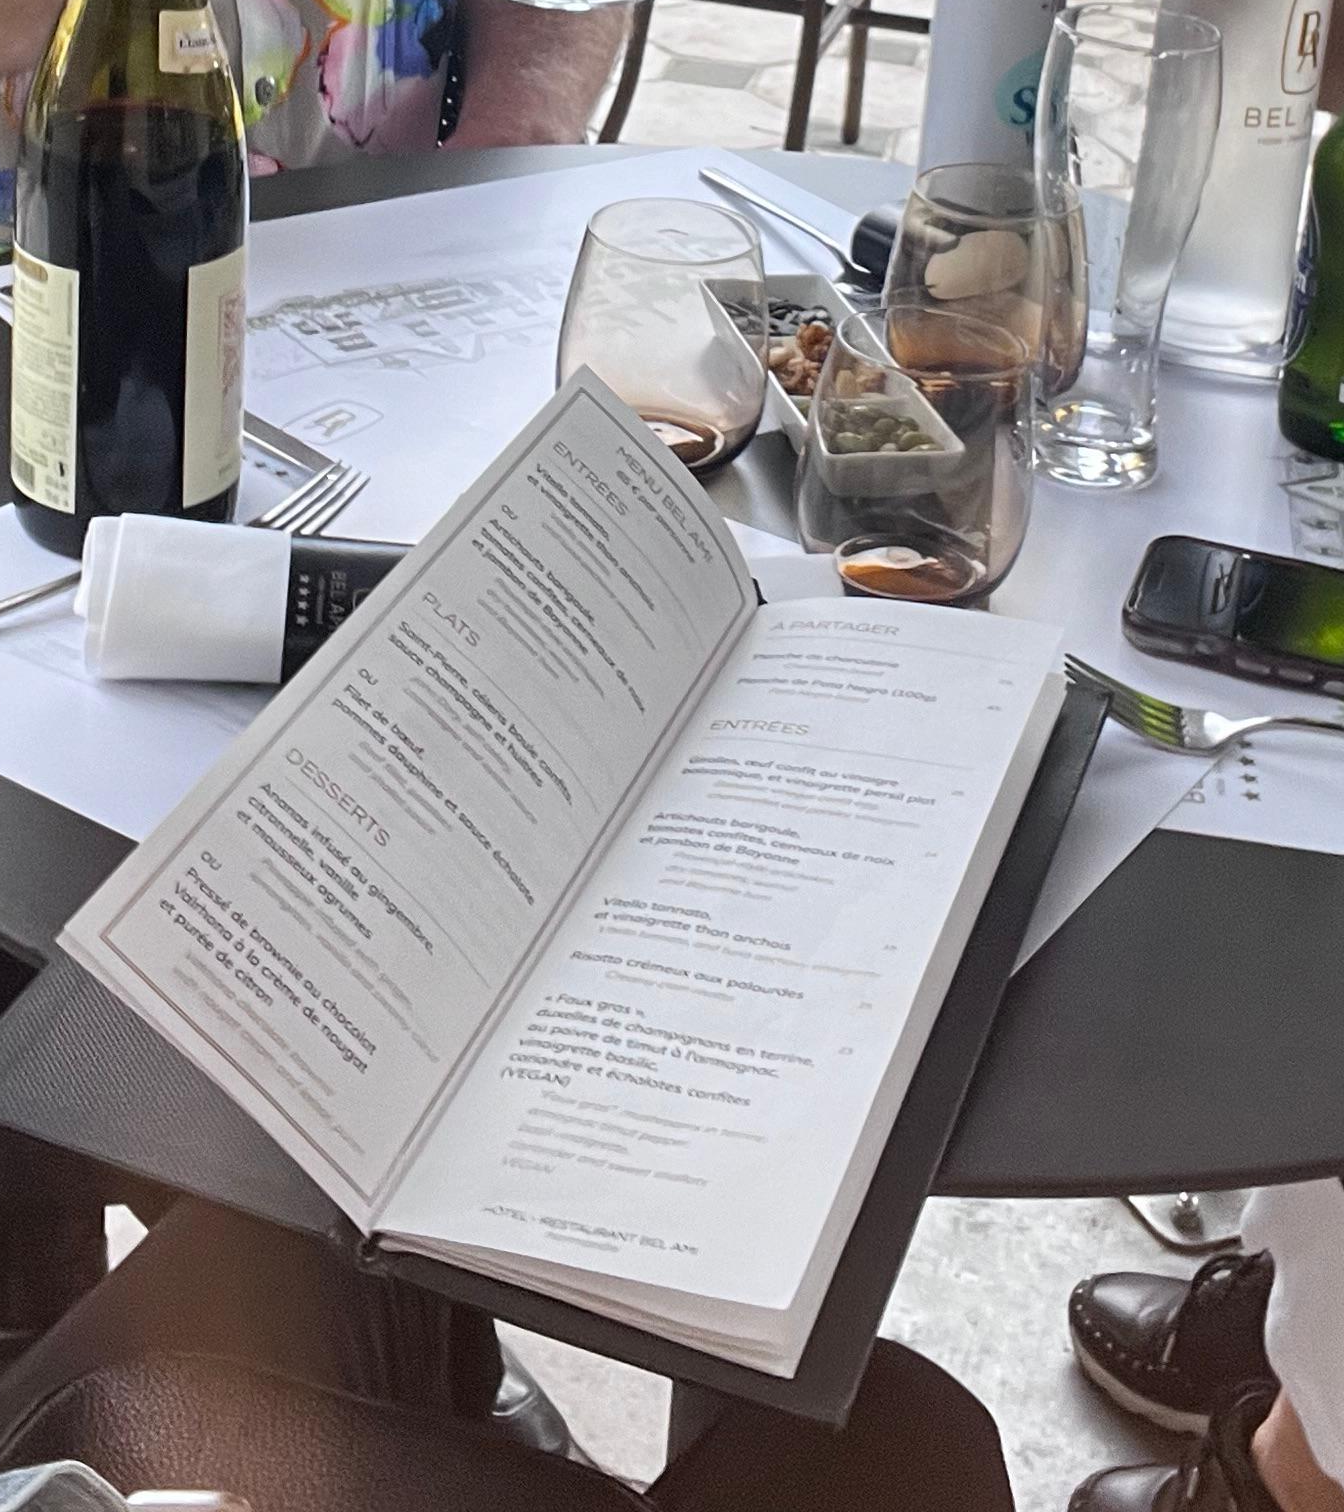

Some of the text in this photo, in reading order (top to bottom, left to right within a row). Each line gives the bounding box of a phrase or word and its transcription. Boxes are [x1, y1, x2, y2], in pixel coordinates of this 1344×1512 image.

[1244, 105, 1296, 129] BEL
[615, 445, 663, 496] MENU
[661, 494, 691, 529] BEL
[525, 474, 539, 486] et
[538, 486, 595, 541] vinaigrette
[595, 540, 620, 567] thon
[488, 516, 547, 572] Artichauts
[470, 537, 590, 655] et jambon de Bayonne
[478, 526, 525, 571] tomates
[615, 668, 629, 685] de
[420, 590, 482, 648] PLATS
[790, 621, 898, 635] PARTAGER
[343, 683, 372, 710] Filet
[370, 707, 390, 726] de
[387, 633, 424, 667] sauce
[423, 665, 494, 732] champagne
[492, 730, 508, 745] et
[507, 723, 540, 759] boule
[331, 697, 387, 745] pommes
[385, 744, 445, 800] dauphine
[443, 797, 459, 813] et
[457, 813, 492, 850] sauce
[786, 777, 859, 794] vinaigrette
[863, 787, 904, 800] persil
[841, 771, 898, 788] vinaigre
[284, 746, 393, 848] DESSERTS
[258, 780, 311, 829] Ananas
[309, 826, 352, 866] infusé
[348, 866, 368, 885] au
[655, 835, 710, 849] jambon
[714, 842, 732, 852] de
[735, 845, 800, 865] Bayonne
[235, 808, 374, 939] et mousseux agrumes
[317, 858, 361, 901] vanille
[841, 850, 860, 860] de
[863, 854, 895, 866] noix
[603, 897, 648, 909] Vitello
[158, 897, 275, 1006] et purée de citron
[594, 910, 791, 951] et vinaigrette thon anchois
[170, 881, 369, 1076] Valrhona à la crème de nougat
[184, 866, 378, 1056] Pressé de brownie au chocolat
[569, 950, 623, 965] Risotto
[625, 958, 689, 977] crémeux
[694, 972, 722, 984] aux
[726, 978, 804, 1000] palourdes
[555, 993, 592, 1007] Faux
[596, 1001, 630, 1014] gras
[519, 1036, 600, 1058] vinaigrette
[550, 1025, 598, 1041] poivre
[602, 1034, 622, 1045] de
[600, 1016, 622, 1028] de
[623, 1021, 731, 1052] champignons
[735, 1045, 756, 1056] en
[500, 1066, 571, 1088] (VEGAN)
[586, 1065, 603, 1076] et
